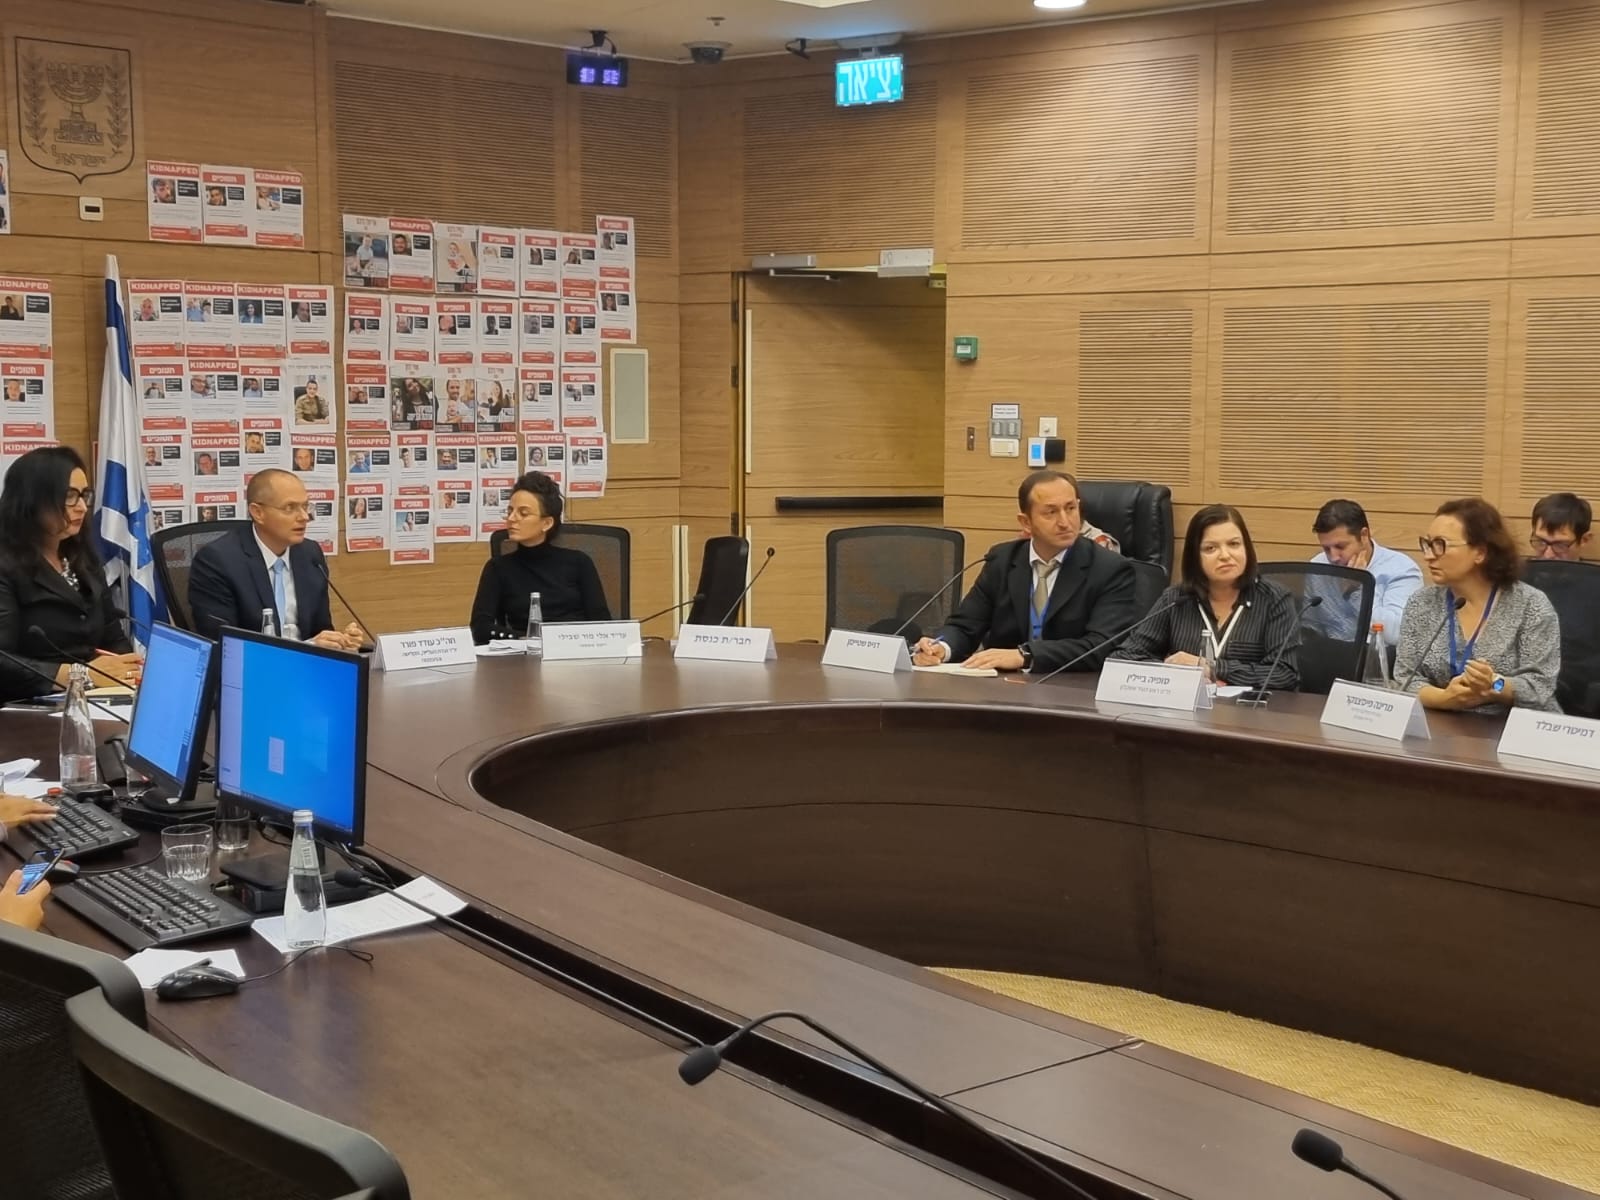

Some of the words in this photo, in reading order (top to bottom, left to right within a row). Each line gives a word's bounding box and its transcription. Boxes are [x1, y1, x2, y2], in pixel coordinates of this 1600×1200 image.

[839, 60, 899, 102] יציאה
[150, 165, 198, 175] KIDNAPPED
[212, 174, 237, 182] חטופים
[256, 173, 300, 183] KIDNAPPED
[391, 221, 431, 230] KIDNAPPED
[132, 283, 180, 291] KIDNAPPED
[186, 284, 233, 292] KIDNAPPED
[239, 286, 283, 294] KIDNAPPED
[190, 361, 237, 369] KIDNAPPED
[10, 366, 36, 374] חטופים
[292, 436, 335, 444] KIDNAPPED
[694, 634, 719, 643] כנסת
[721, 637, 751, 645] חבר/ת
[418, 639, 435, 648] עודד
[1126, 674, 1147, 684] ביילין
[1148, 676, 1170, 684] סופיה
[1374, 700, 1394, 712] מרינה
[1536, 720, 1562, 732] שבלד
[1562, 725, 1595, 738] דמיטרי
